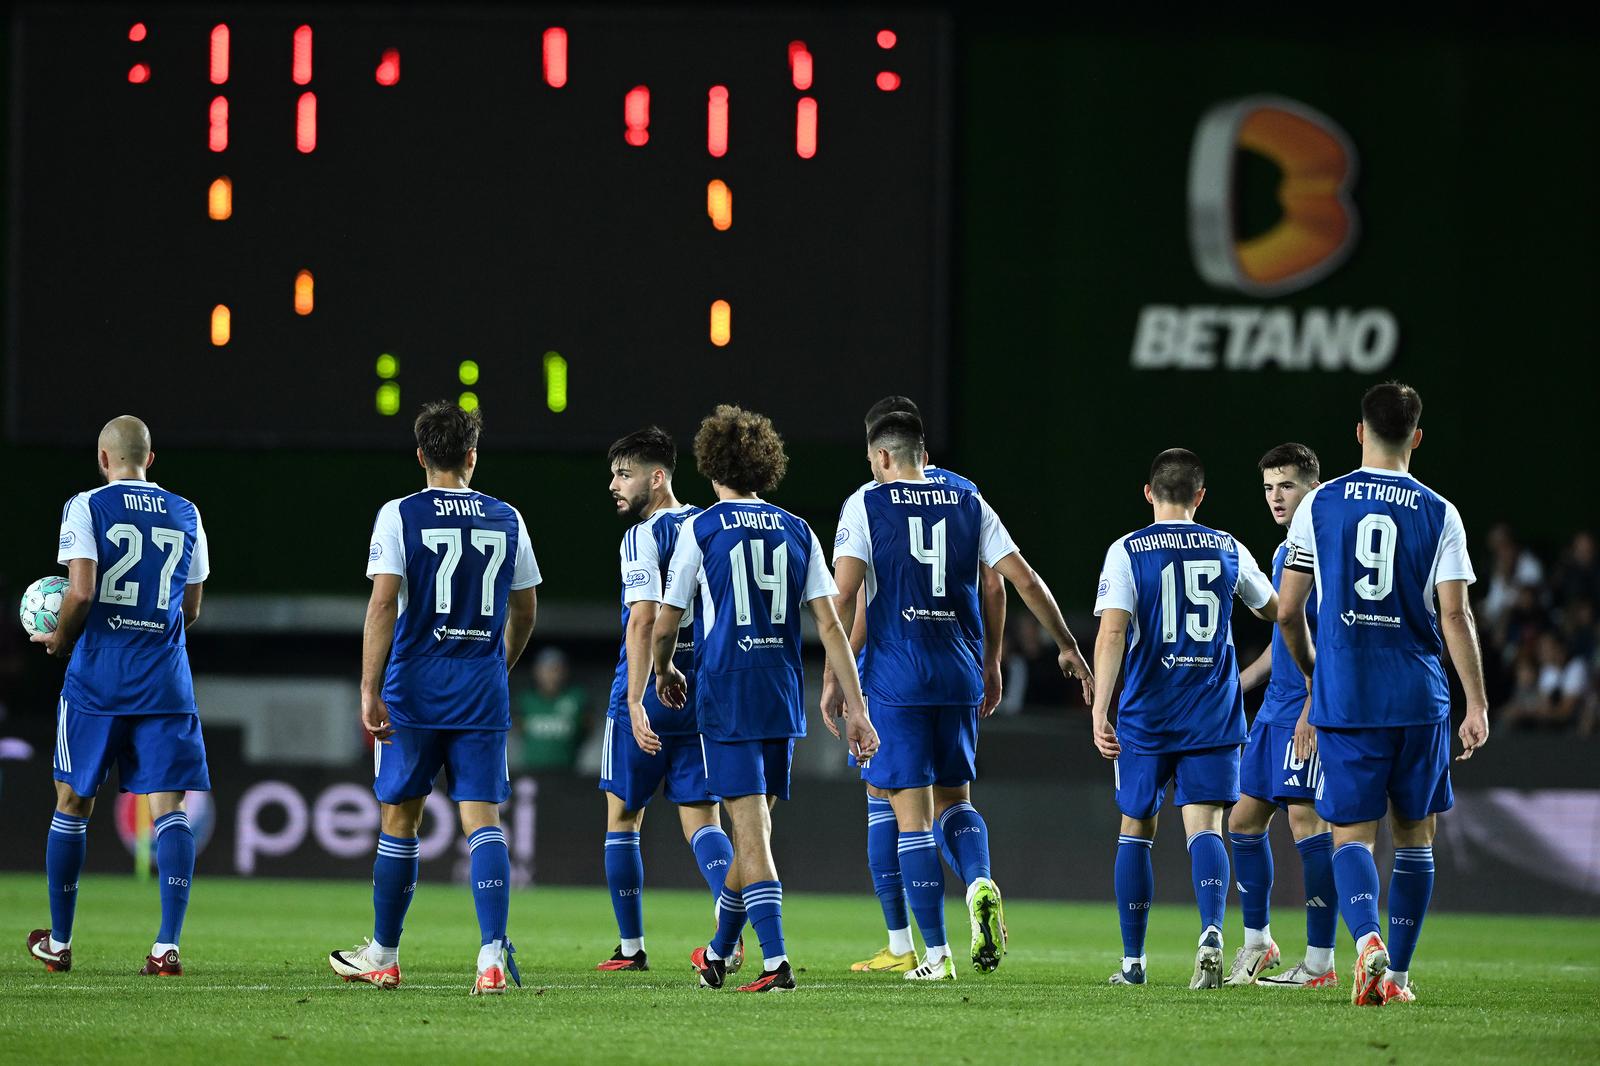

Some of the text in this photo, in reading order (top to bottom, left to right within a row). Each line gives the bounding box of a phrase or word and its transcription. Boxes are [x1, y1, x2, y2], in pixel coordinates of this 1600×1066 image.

[1131, 305, 1400, 373] BETANO
[123, 494, 167, 514] MIŠIĆ
[890, 488, 959, 506] B.ŠUTALO
[1344, 482, 1421, 511] PETKOVIĆ
[433, 497, 486, 517] ŠPIKIĆ
[719, 511, 785, 531] LJUBIČIĆ
[908, 516, 947, 597] 4
[1354, 513, 1398, 601] 9
[99, 523, 185, 610] 27
[421, 527, 507, 617] 77
[729, 539, 788, 626] 14
[1161, 560, 1222, 643] 15
[122, 618, 166, 630] NEMA PREDAJE
[1356, 613, 1401, 624] NEMA PREDAJE
[447, 628, 492, 638] NEMA PREDAJE
[235, 777, 538, 875] pei
[706, 858, 728, 870] DZG
[168, 876, 189, 887] DZG
[477, 879, 503, 889] DZG
[1200, 879, 1223, 888] DZG
[619, 887, 640, 897] DZG
[1351, 893, 1373, 904] DZG
[1129, 902, 1150, 910] DZG
[1391, 917, 1414, 926] DZG
